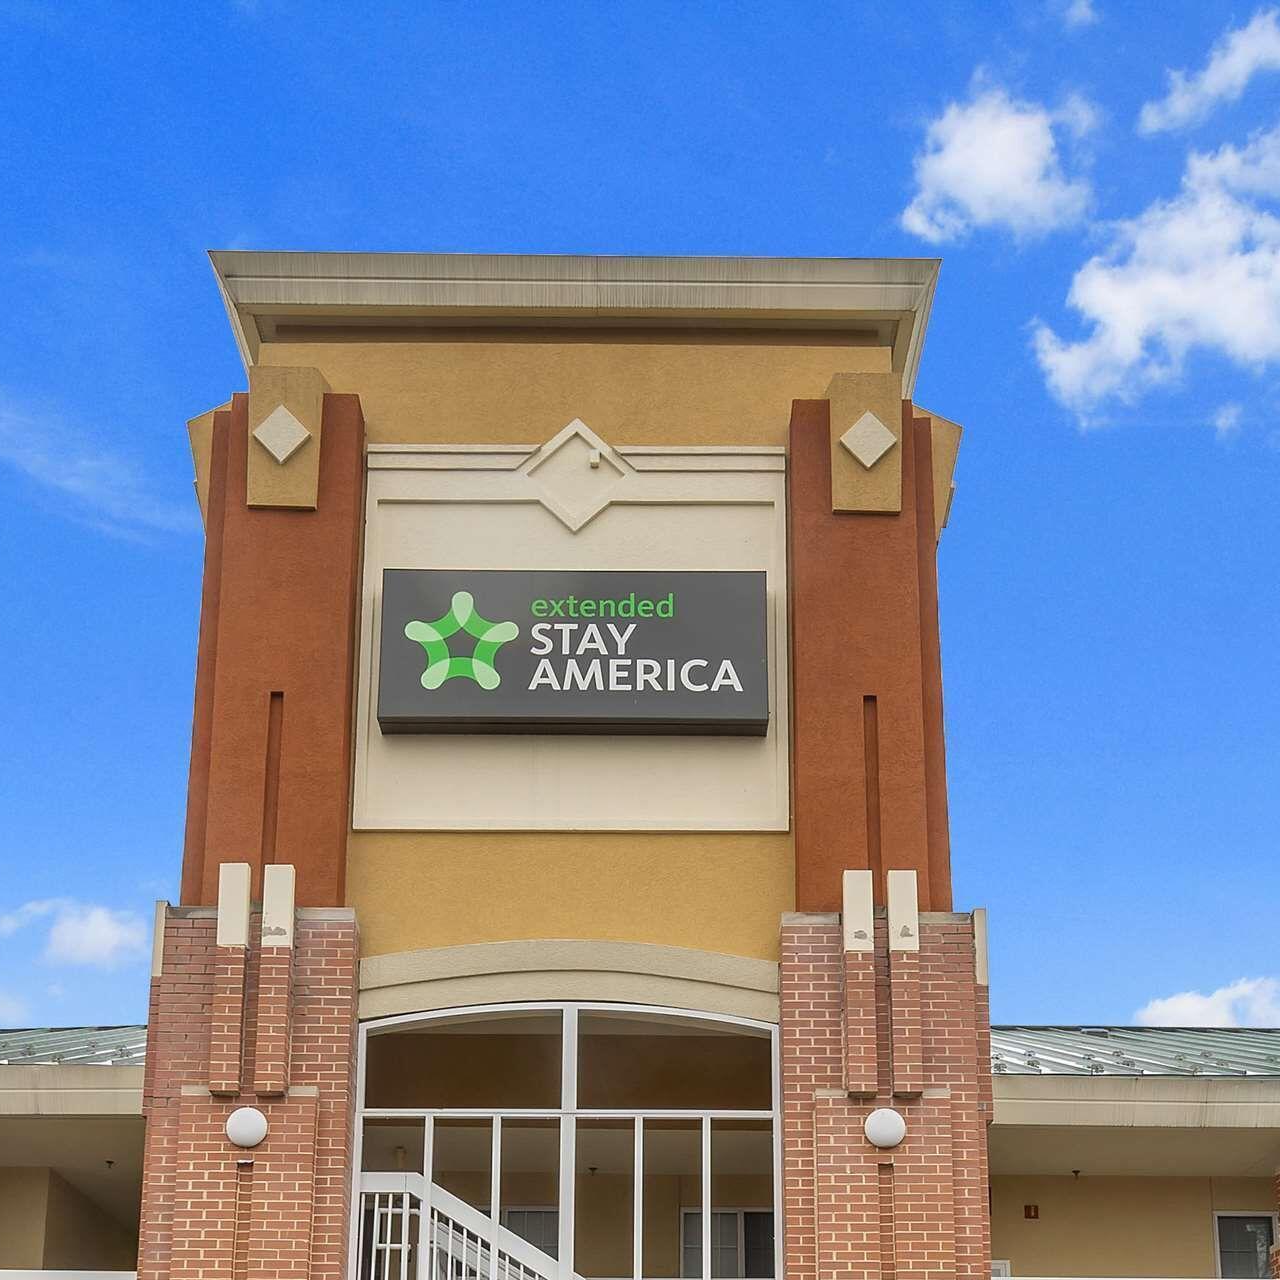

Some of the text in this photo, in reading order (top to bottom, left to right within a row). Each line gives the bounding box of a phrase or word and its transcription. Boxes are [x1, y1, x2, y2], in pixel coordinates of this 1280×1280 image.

[531, 592, 675, 617] extended
[530, 623, 637, 655] STAY
[528, 658, 744, 692] AMERICA
